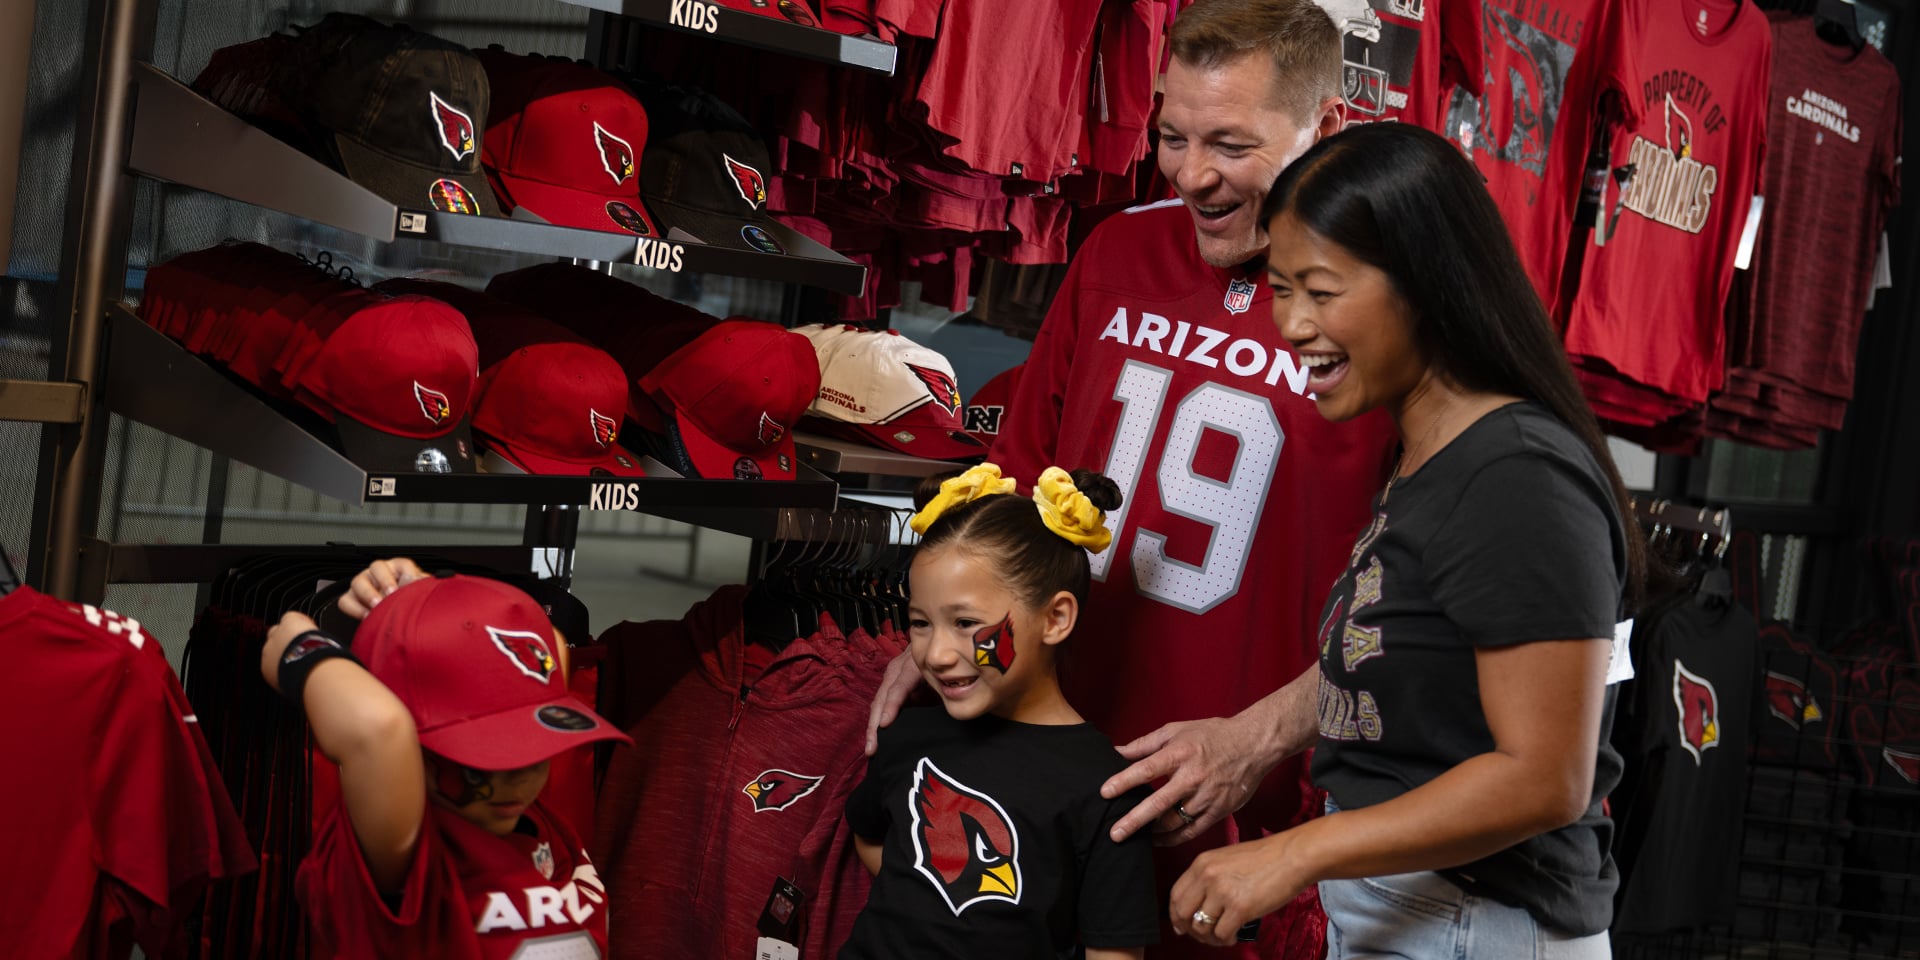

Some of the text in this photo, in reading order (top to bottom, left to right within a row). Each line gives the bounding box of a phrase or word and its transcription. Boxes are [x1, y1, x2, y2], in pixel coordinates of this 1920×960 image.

[669, 0, 719, 34] KIDS
[1643, 70, 1726, 135] PROPERTY OF
[1786, 96, 1860, 143] CARDINALS
[1802, 88, 1848, 120] ARIZONA
[634, 238, 685, 273] KIDS
[1226, 291, 1250, 309] NFL
[1097, 307, 1316, 401] ARIZON
[817, 391, 866, 413] RDINALS
[820, 386, 854, 403] ARIZONA
[589, 483, 640, 511] KIDS
[1088, 358, 1284, 615] 19
